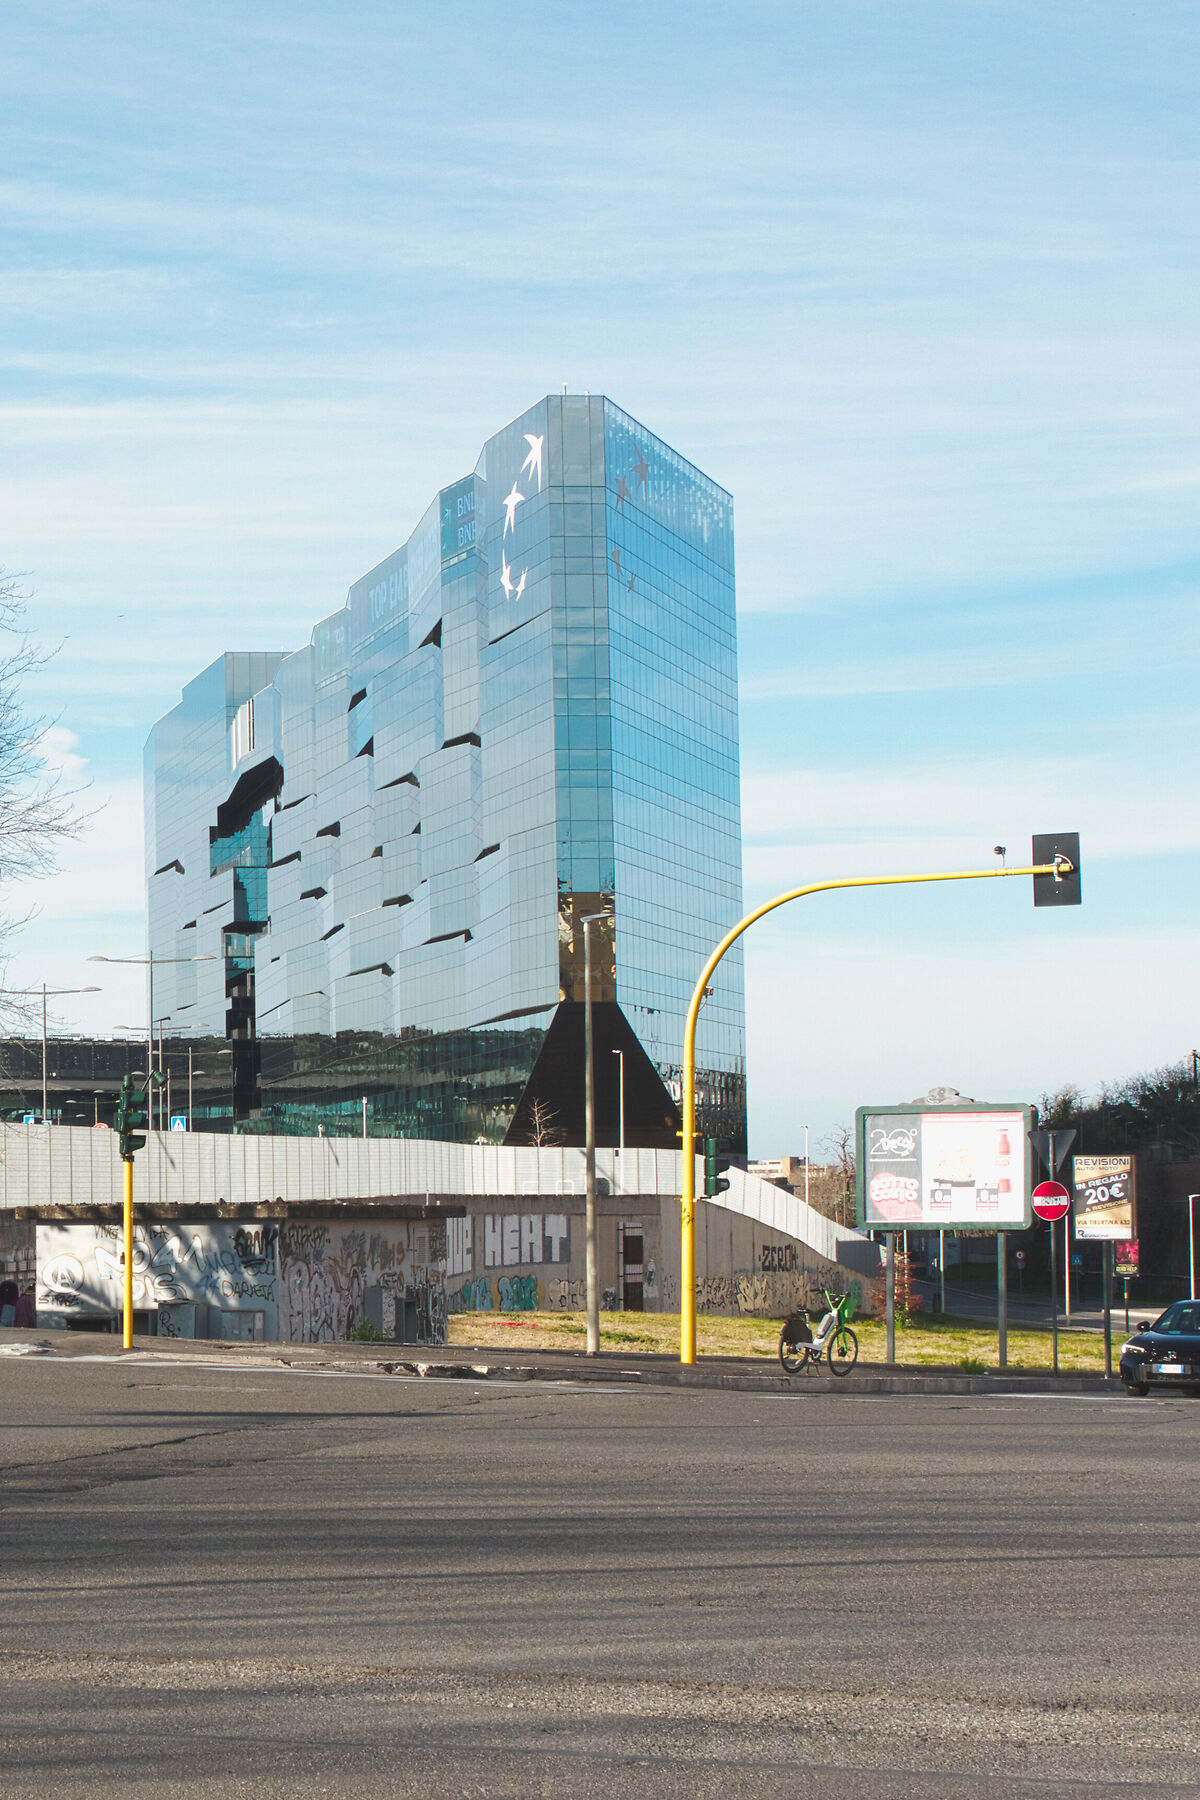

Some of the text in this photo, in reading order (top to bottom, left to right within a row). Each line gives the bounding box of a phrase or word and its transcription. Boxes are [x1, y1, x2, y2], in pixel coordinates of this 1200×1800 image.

[457, 491, 475, 517] BNL
[1075, 1158, 1129, 1166] REVISIONI
[1075, 1172, 1128, 1191] IN REGALO
